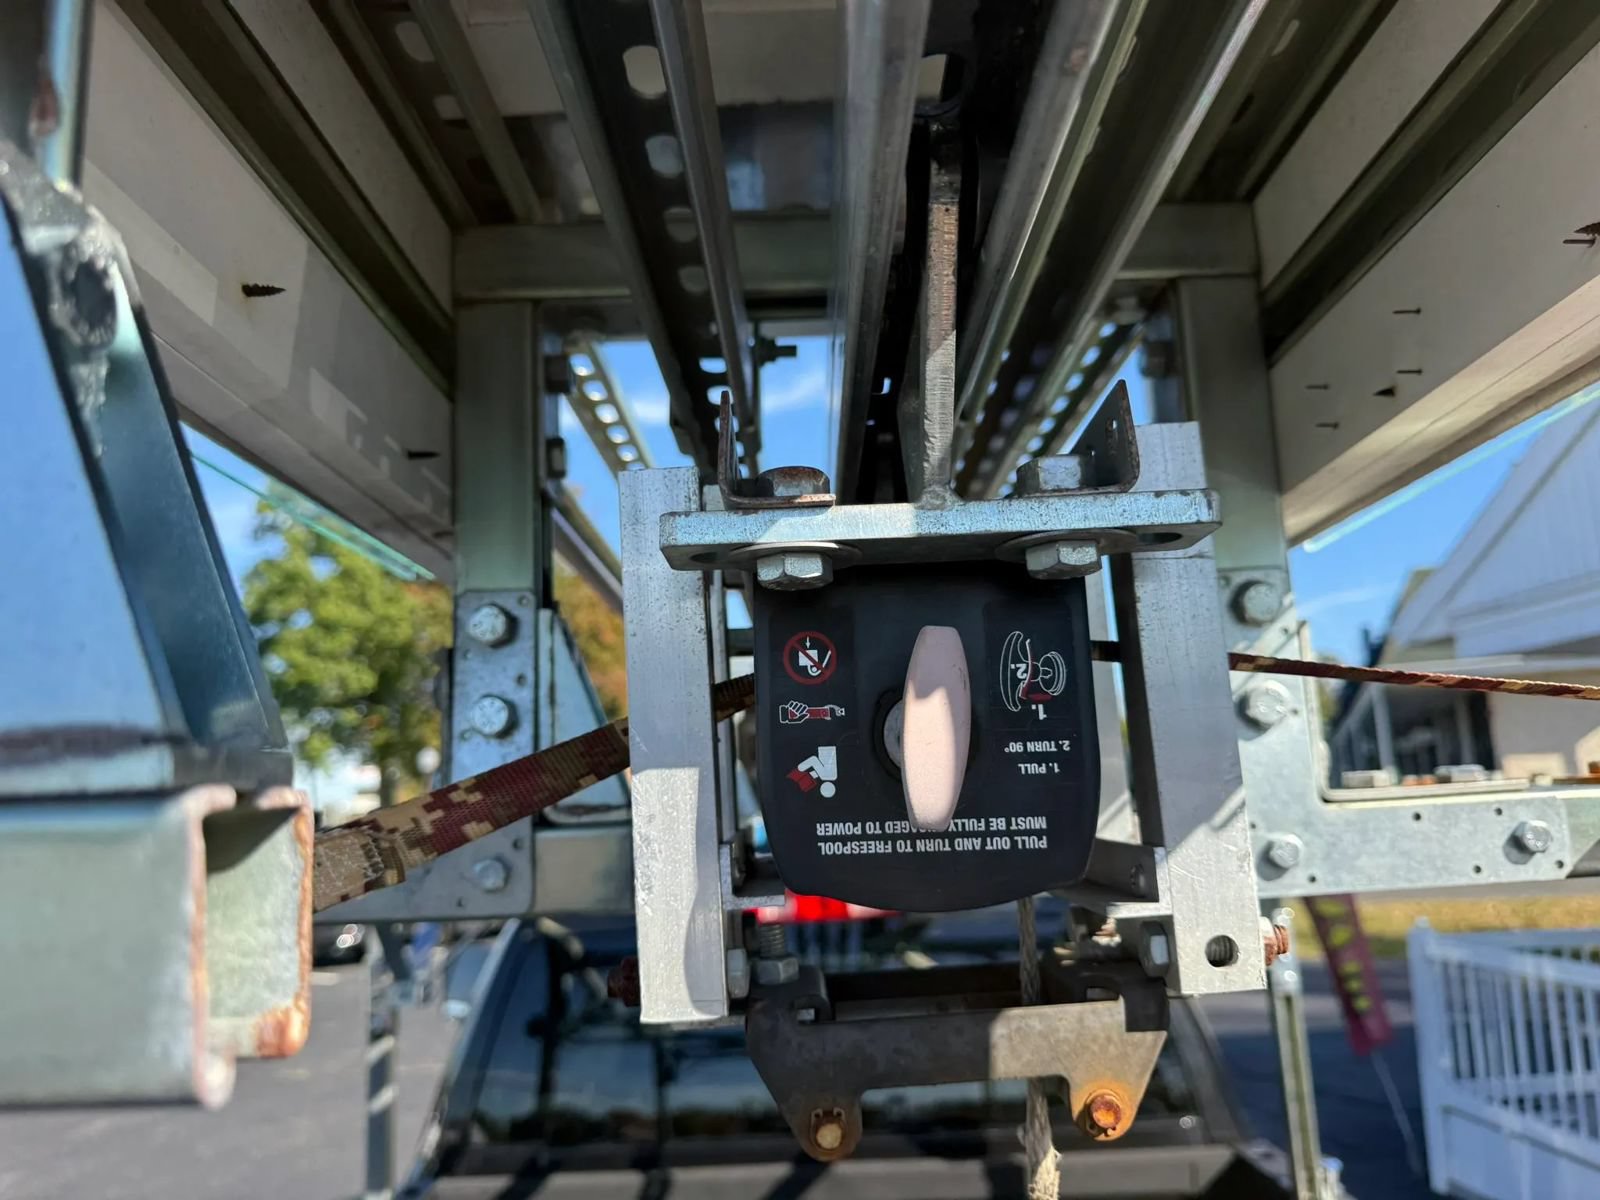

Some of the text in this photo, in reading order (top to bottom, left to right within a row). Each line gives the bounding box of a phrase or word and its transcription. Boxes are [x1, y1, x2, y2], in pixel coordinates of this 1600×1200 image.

[1010, 663, 1028, 679] 2.
[1031, 703, 1047, 720] 1.
[1027, 740, 1057, 752] TURN
[1059, 740, 1071, 751] 2.
[1018, 762, 1060, 775] 1. PULL
[816, 822, 862, 836] POWER
[865, 821, 882, 834] TO
[948, 818, 985, 832] FULLY
[988, 817, 1006, 831] BE
[1009, 816, 1047, 830] MUST
[817, 835, 1047, 855] PULL OUT AND TURN TO FREESPOOL
